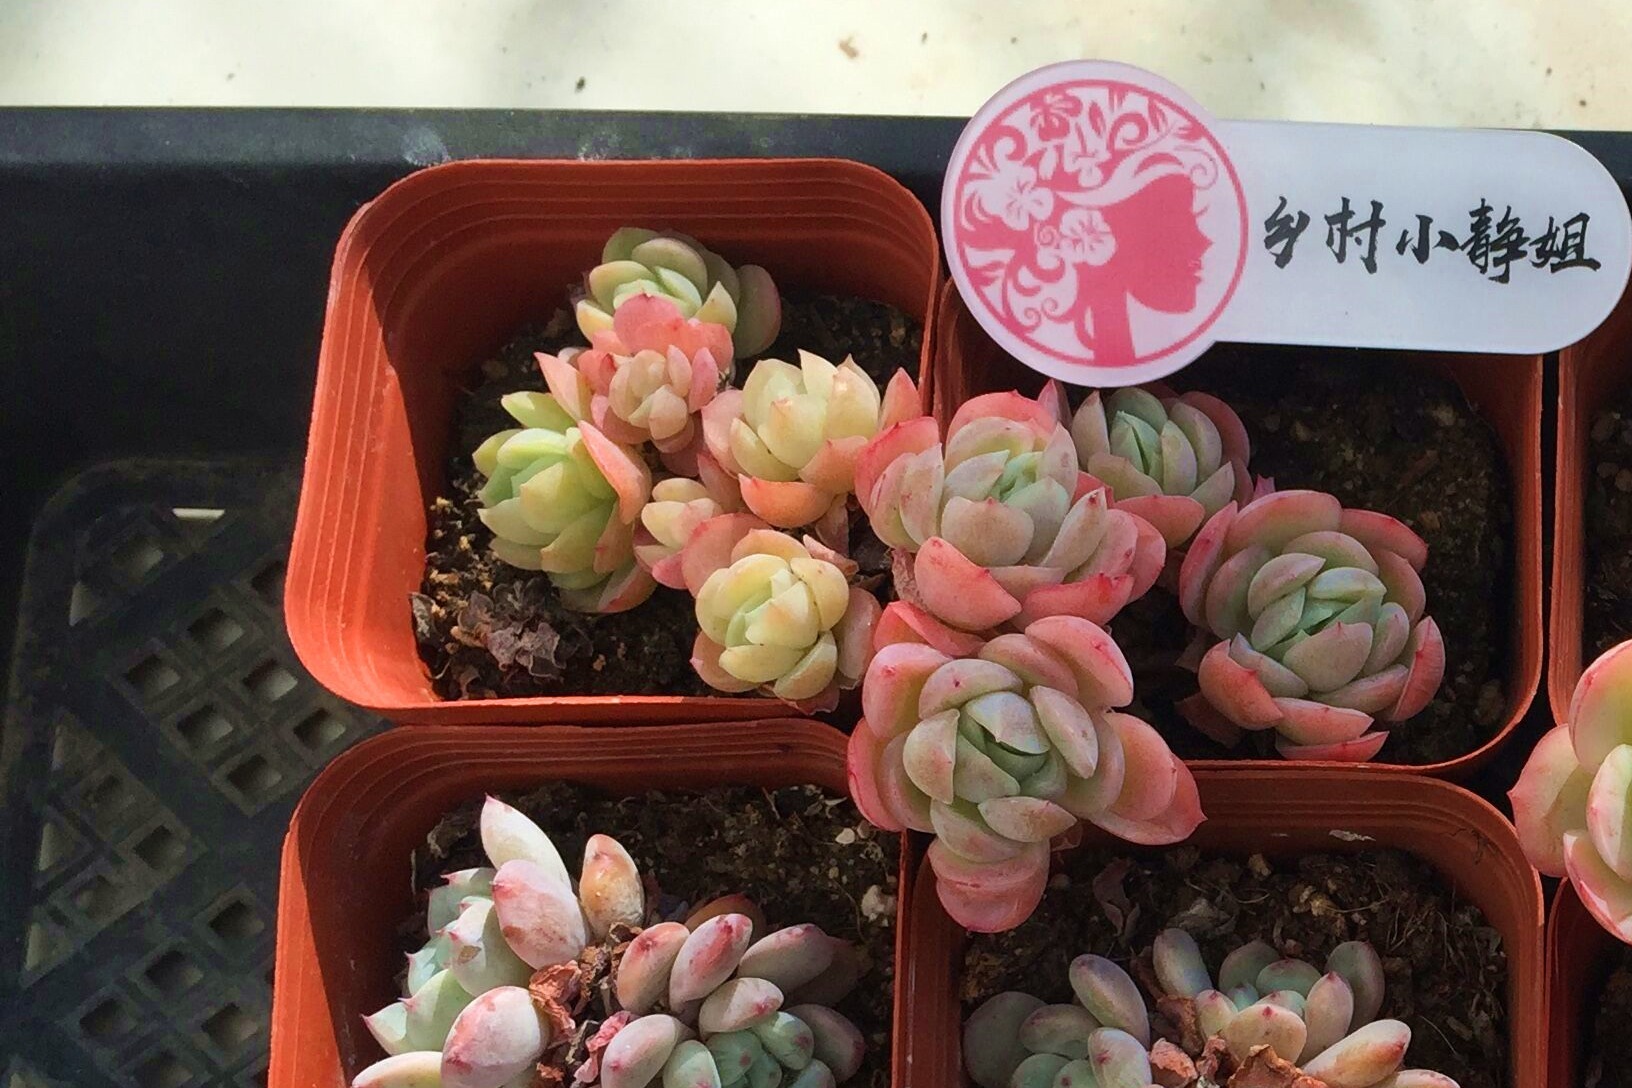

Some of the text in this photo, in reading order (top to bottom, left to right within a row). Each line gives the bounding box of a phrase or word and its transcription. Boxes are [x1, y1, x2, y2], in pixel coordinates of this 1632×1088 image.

[1263, 195, 1601, 284] 乡村小静姐
